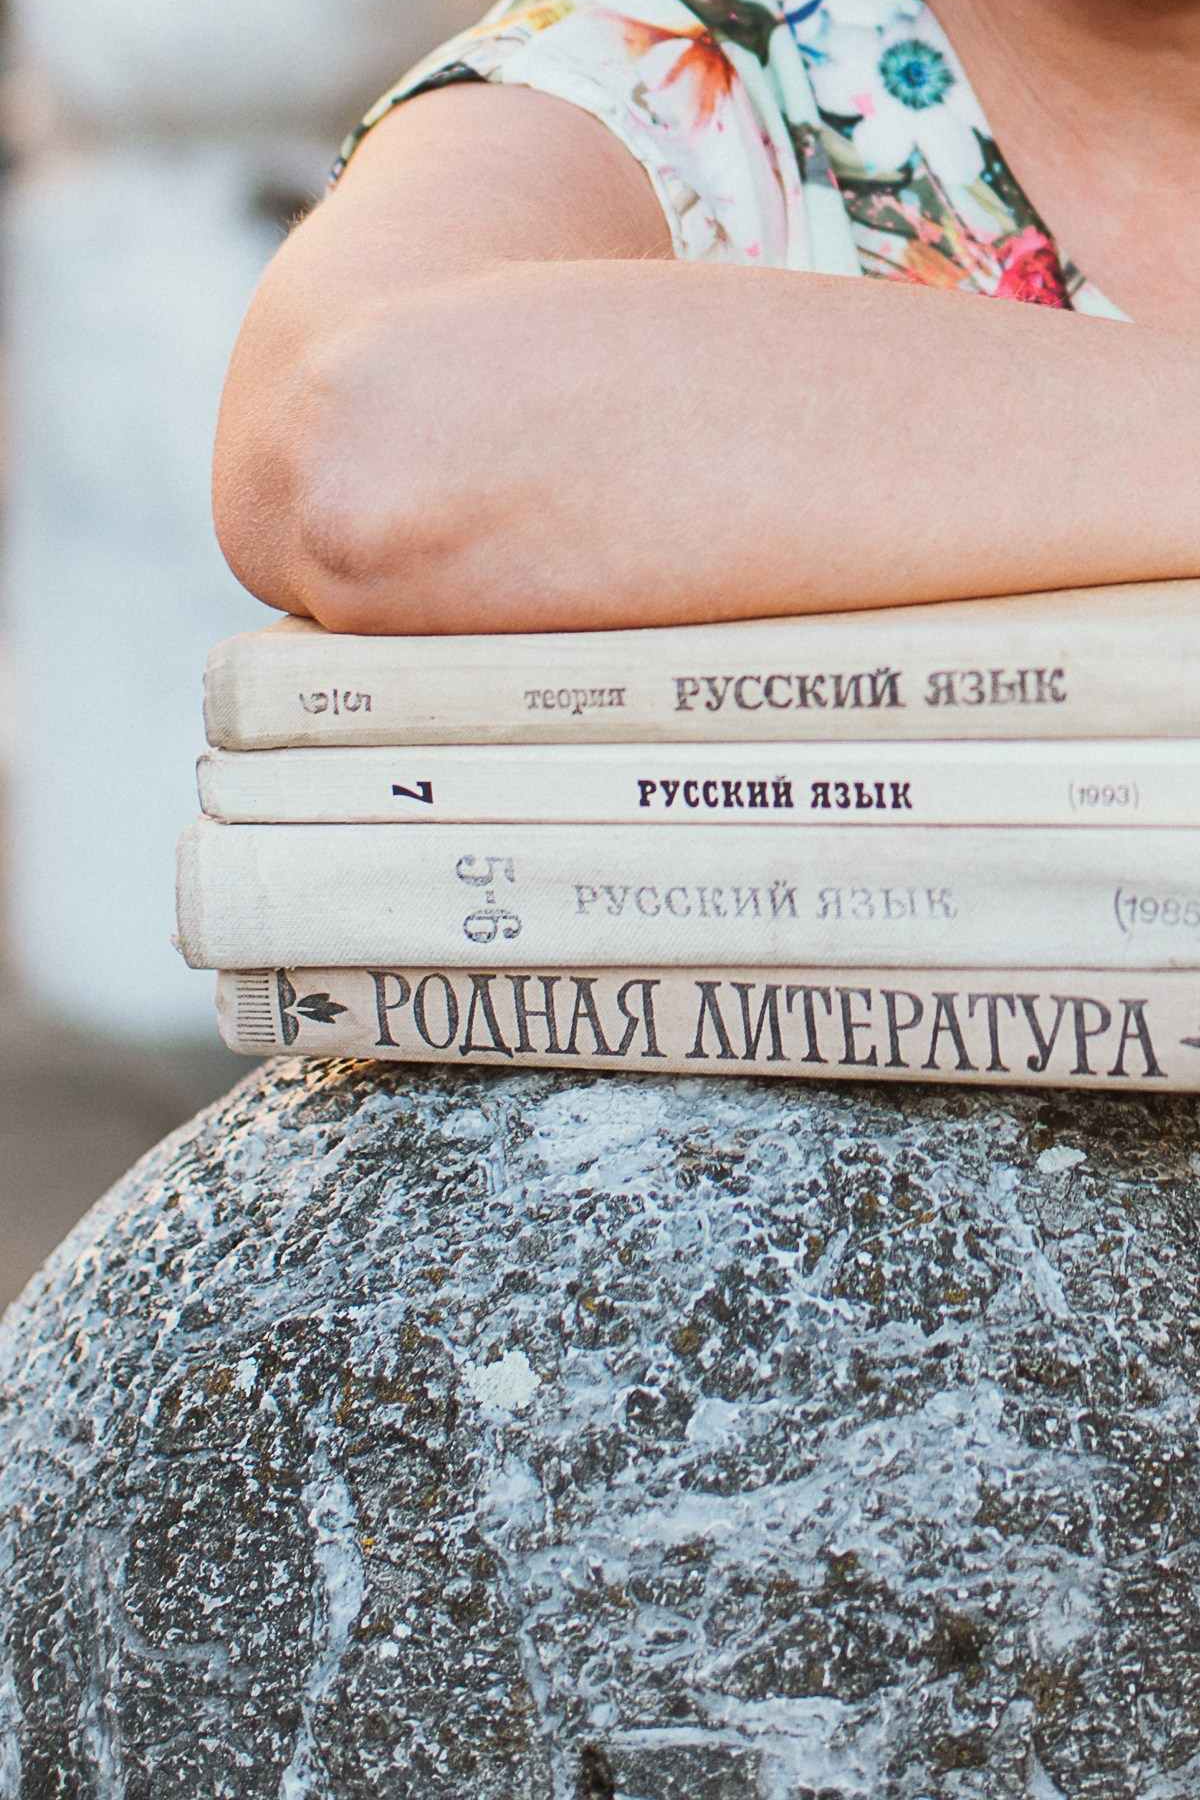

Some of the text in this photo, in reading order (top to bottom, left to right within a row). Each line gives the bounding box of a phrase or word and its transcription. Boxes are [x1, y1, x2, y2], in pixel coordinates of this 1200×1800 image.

[524, 686, 625, 715] теория
[674, 667, 906, 711] РУССКИЙ
[924, 667, 1067, 706] ЯЗЫК
[392, 781, 433, 804] 7
[637, 775, 1139, 813] РУССКИЙ ЯЗЫК (1993)
[574, 880, 797, 919] РУССКИЙ
[816, 886, 958, 920] ЯЗЫК
[366, 970, 1168, 1078] РОДНАЯ ЛИТЕРАТУРА
